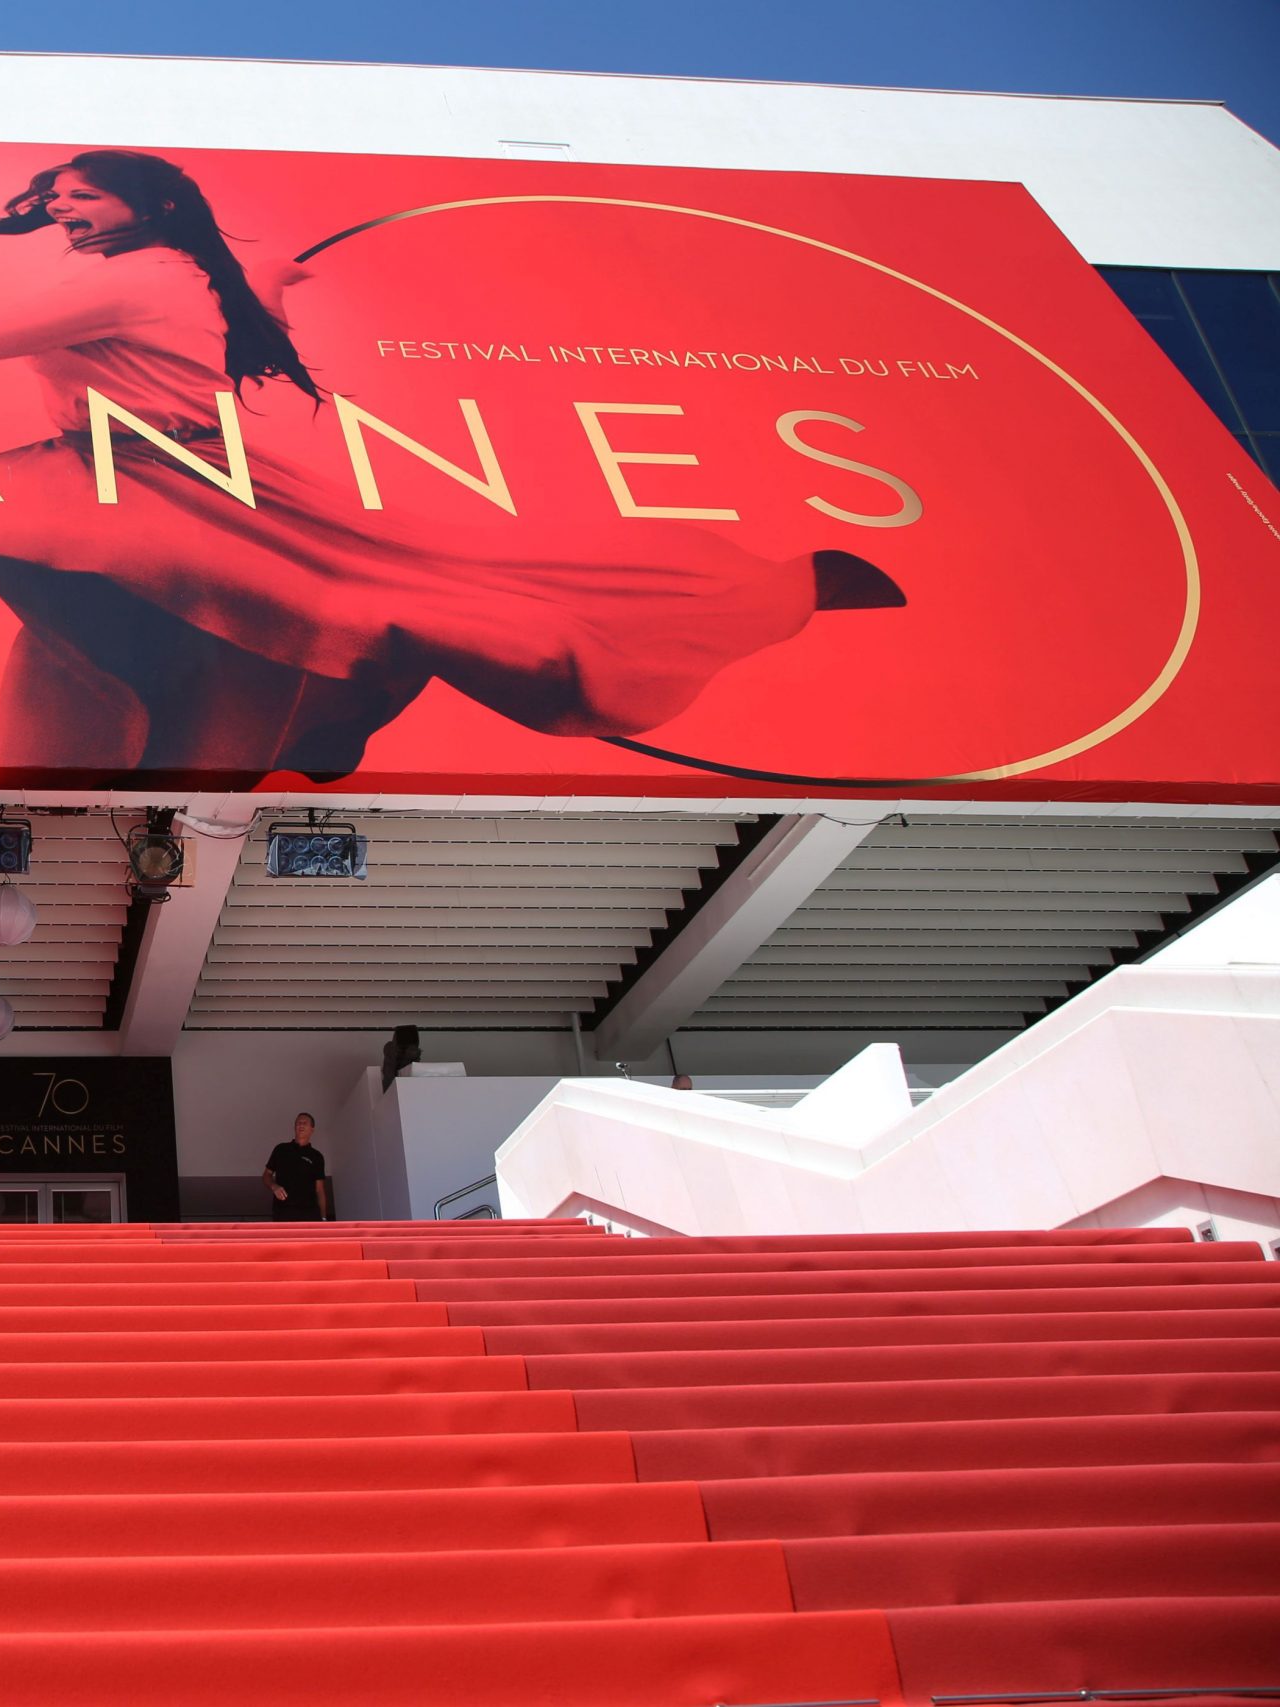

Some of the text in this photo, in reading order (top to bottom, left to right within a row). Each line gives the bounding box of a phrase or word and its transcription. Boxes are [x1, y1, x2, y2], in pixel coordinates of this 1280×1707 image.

[376, 339, 980, 380] FESTIVAL INTERNATIONAL DU FILM
[32, 1072, 90, 1118] 70
